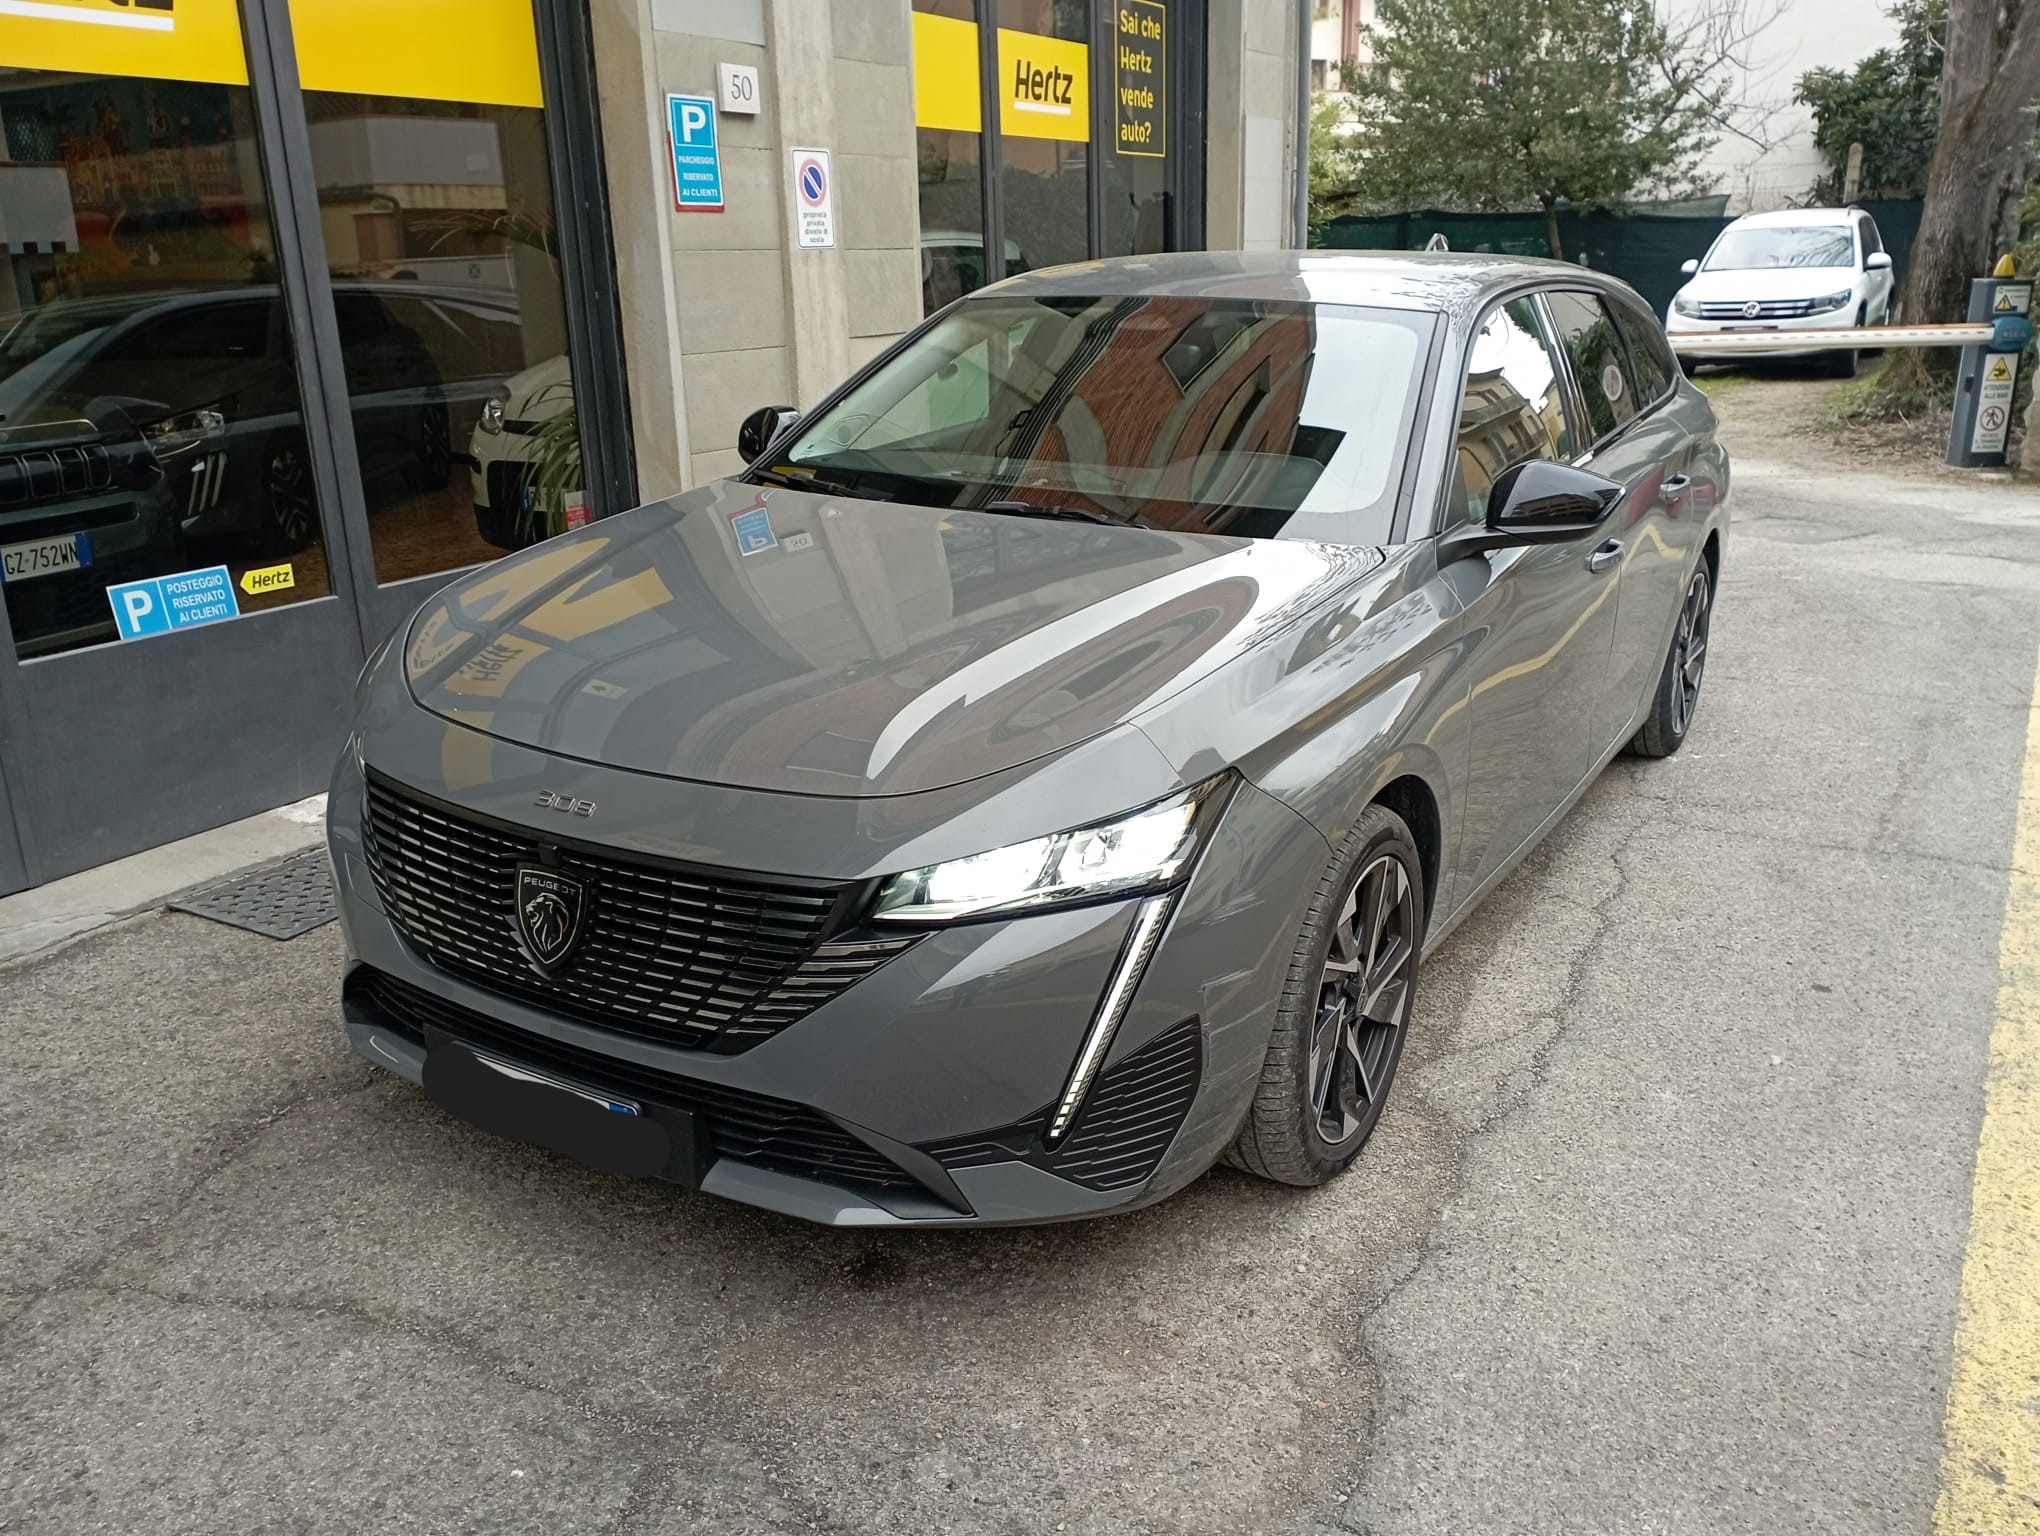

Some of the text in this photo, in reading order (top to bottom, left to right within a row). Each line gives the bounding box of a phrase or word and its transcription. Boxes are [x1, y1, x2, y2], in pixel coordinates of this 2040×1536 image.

[1120, 9, 1161, 40] Sai che
[1120, 45, 1152, 74] Hertz
[731, 74, 753, 101] 50
[1014, 59, 1073, 105] Hertz
[1120, 86, 1154, 109] vende
[681, 104, 707, 143] P
[1121, 120, 1152, 143] auto?
[678, 155, 715, 165] PARCHEGGIO
[683, 172, 714, 181] RISERVATO
[682, 188, 718, 197] AI CLIENTI
[4, 542, 79, 575] GZ 752WN
[166, 575, 223, 595] POSTEGGIO
[252, 569, 291, 589] Hertz
[172, 589, 226, 609] RISERVATO
[122, 590, 153, 633] P
[179, 604, 228, 623] AI CLIENTI
[535, 789, 597, 817] 308
[523, 876, 577, 896] PEUGEOT
